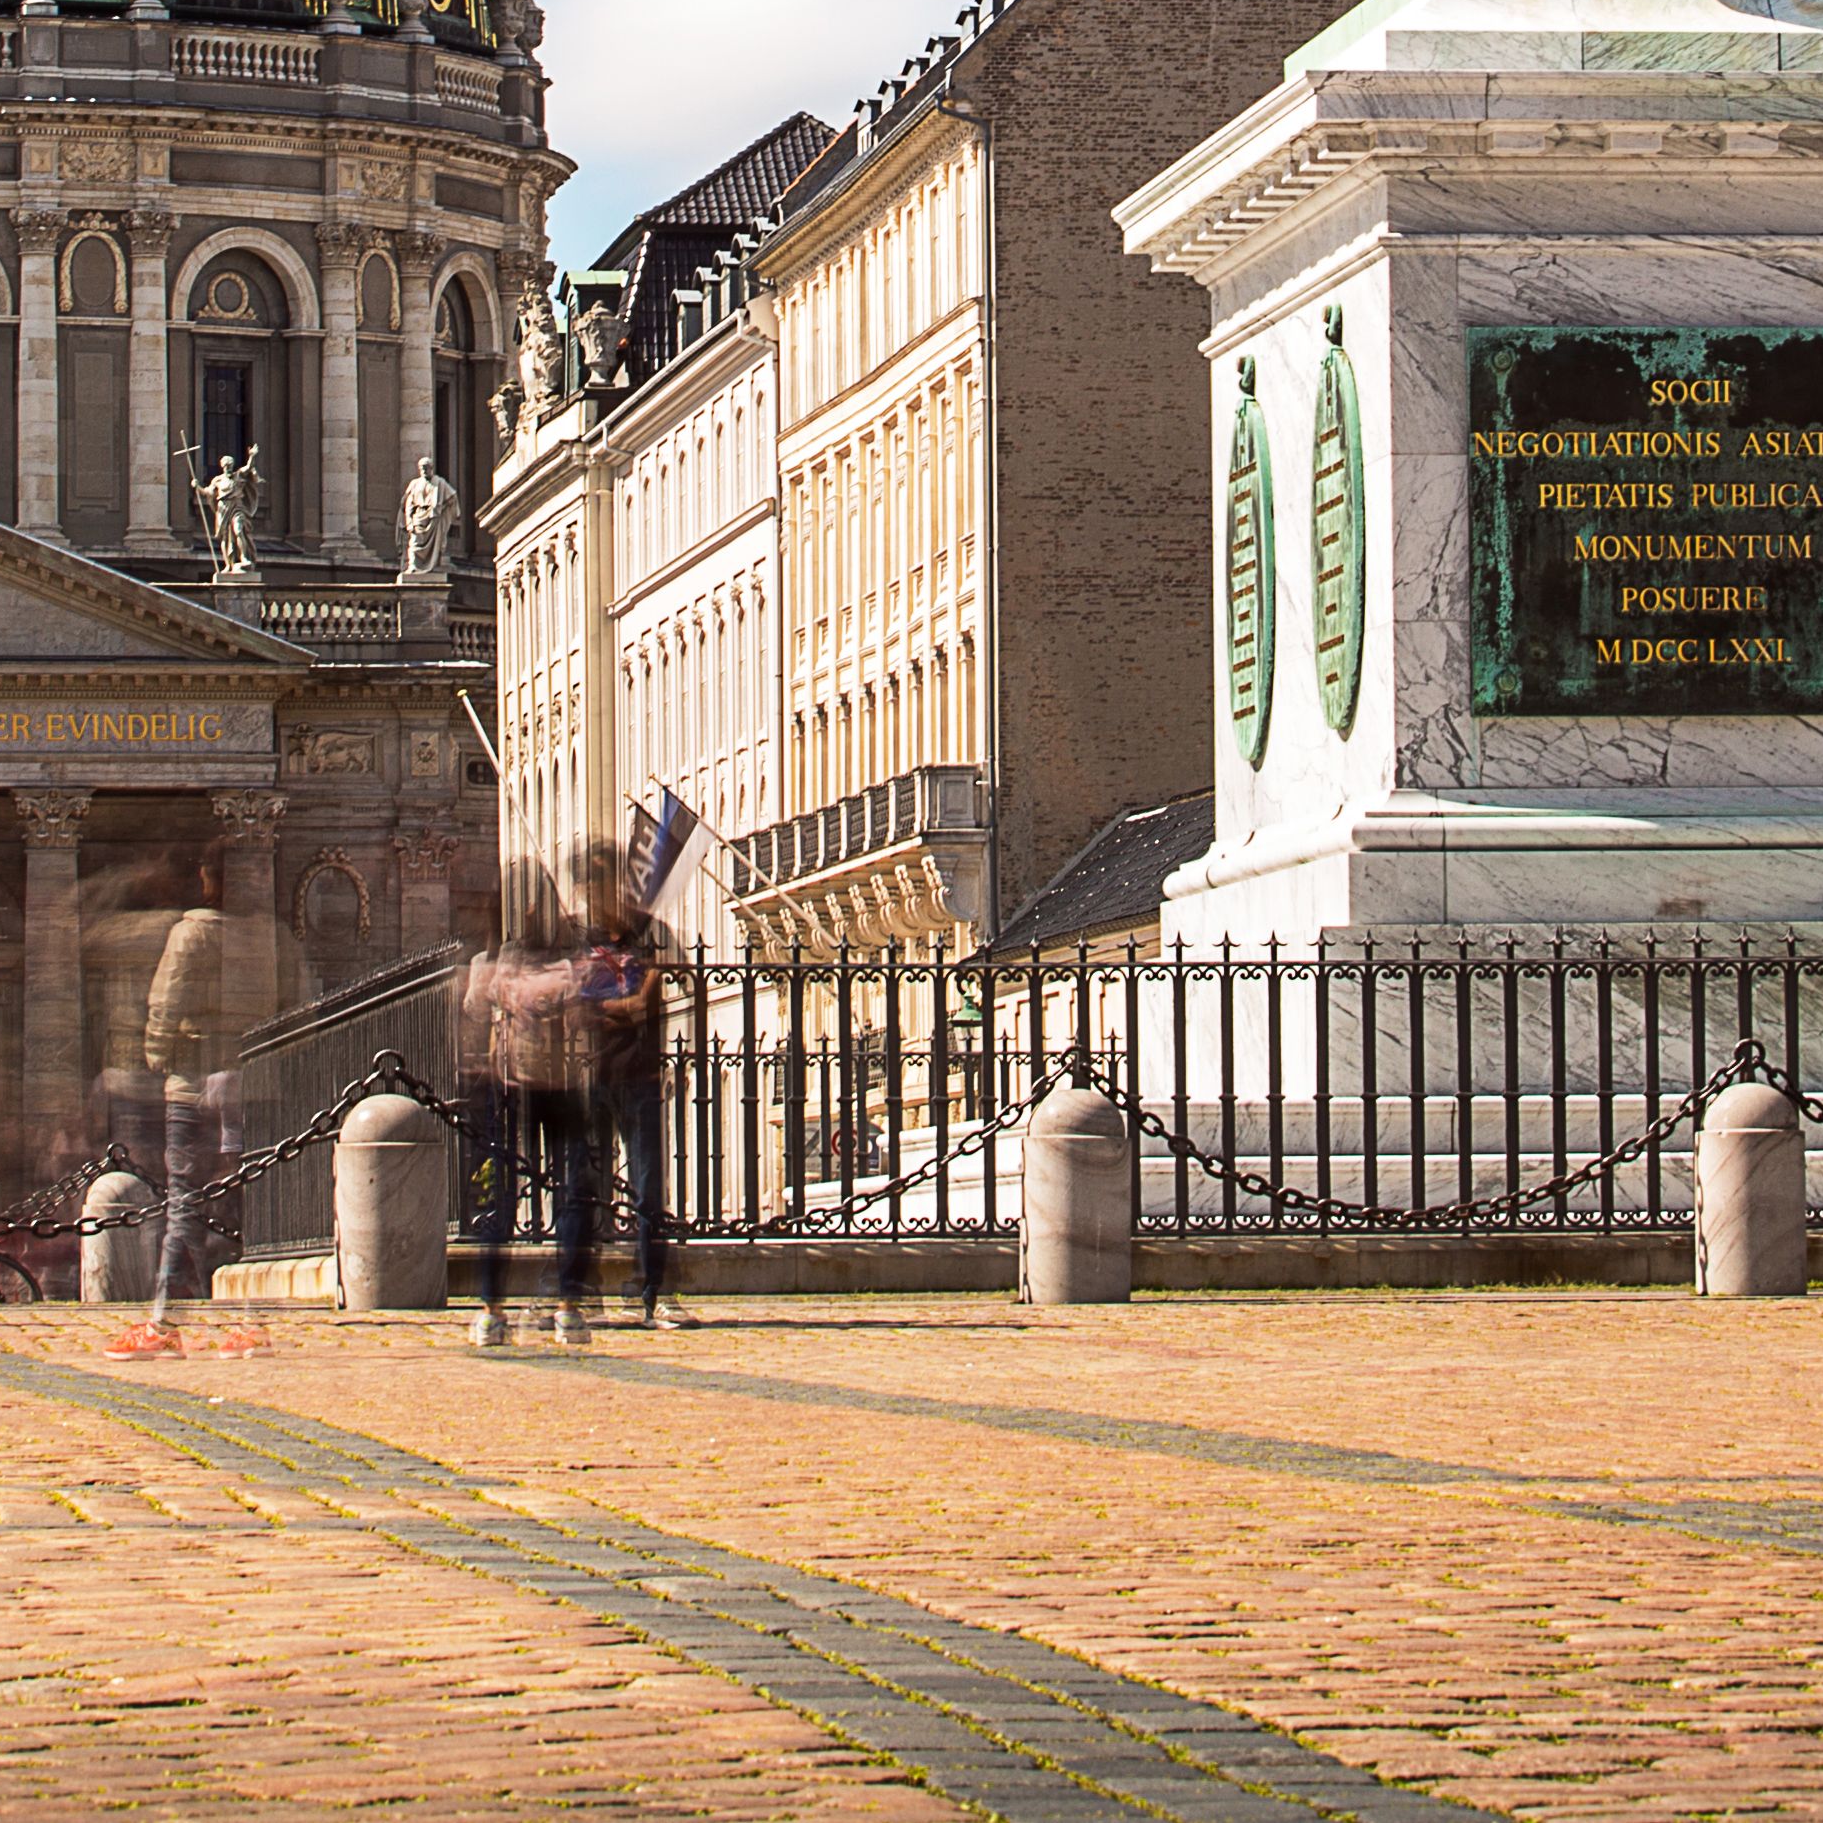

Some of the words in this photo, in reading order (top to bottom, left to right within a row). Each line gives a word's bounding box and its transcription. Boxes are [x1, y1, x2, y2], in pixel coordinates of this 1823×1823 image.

[1650, 379, 1731, 406] SOCII
[1474, 431, 1721, 458] NEGOTIATIONIS
[1539, 483, 1674, 510] PIETATIS
[1574, 534, 1812, 562] MONUMENTUM
[1621, 586, 1766, 613] POSUERE
[45, 711, 223, 742] EVINDELIG
